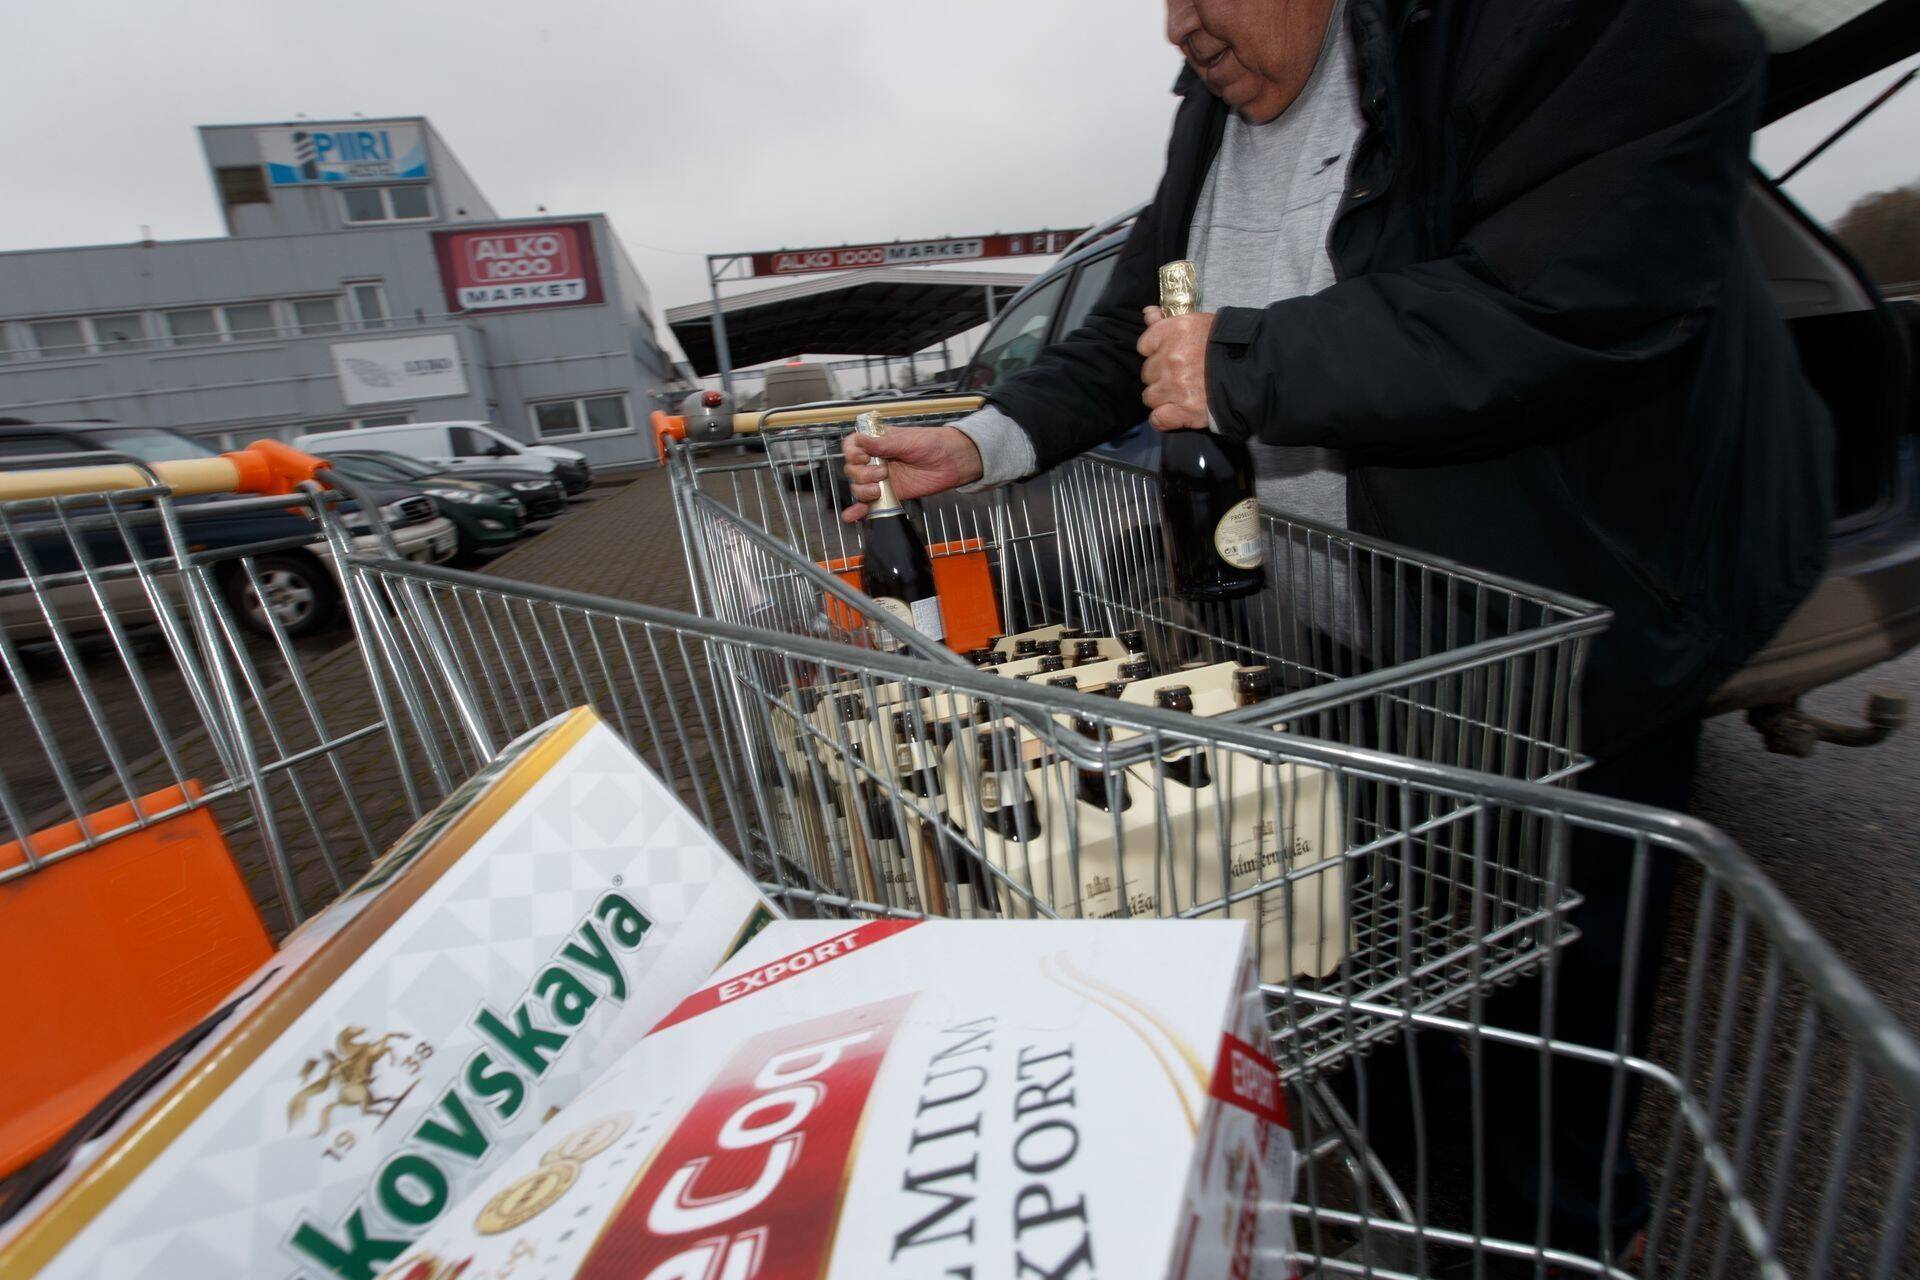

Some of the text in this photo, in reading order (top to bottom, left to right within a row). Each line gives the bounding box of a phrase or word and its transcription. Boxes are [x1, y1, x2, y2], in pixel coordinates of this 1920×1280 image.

[313, 130, 392, 162] PIIRI
[475, 236, 559, 261] ALKO
[778, 241, 979, 271] ALKO 1000 MARKET
[487, 258, 552, 278] 1000
[468, 282, 579, 303] MARKET
[718, 932, 861, 1002] EXPORT
[291, 893, 653, 1280] kovskaya
[647, 1026, 884, 1236] Coq
[889, 1014, 998, 1280] MIUM
